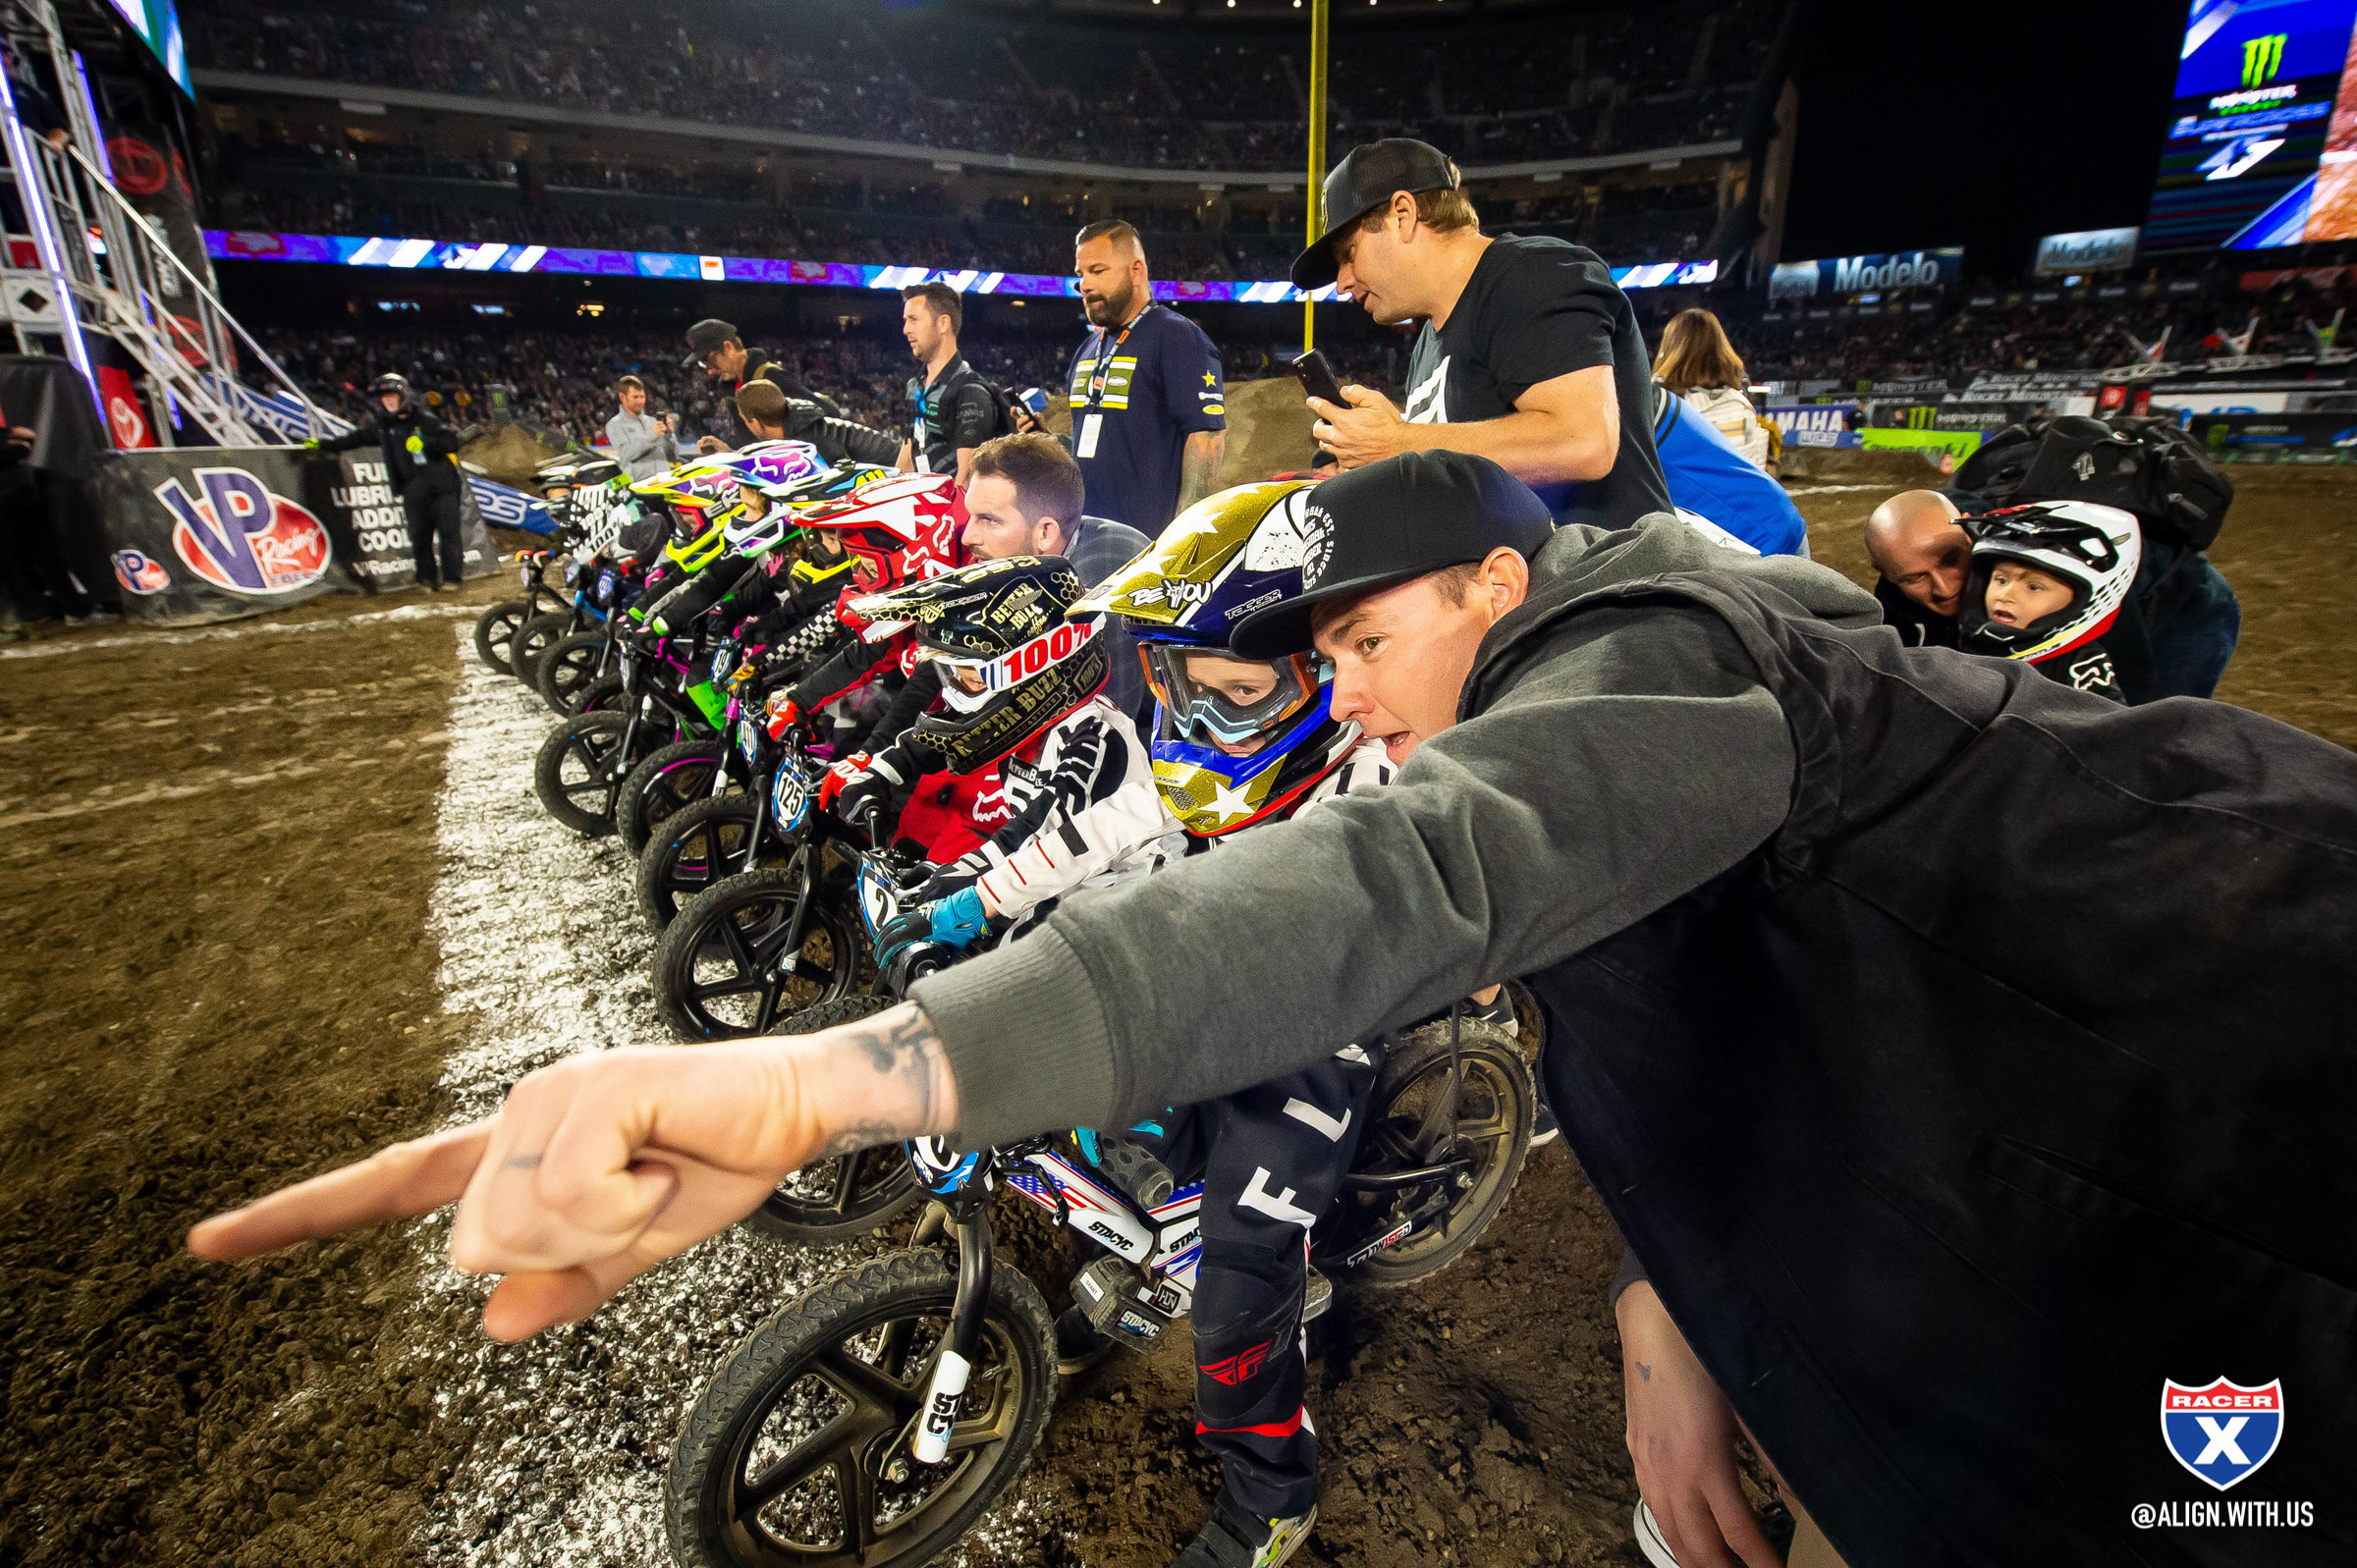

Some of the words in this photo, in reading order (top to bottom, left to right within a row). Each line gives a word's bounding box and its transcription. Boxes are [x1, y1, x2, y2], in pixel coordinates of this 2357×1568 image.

[1833, 250, 1940, 293] Modelo
[1765, 410, 1843, 435] AMAHA
[155, 467, 276, 590] VP
[255, 526, 323, 577] Racing
[990, 582, 1035, 625] BETTER
[1128, 587, 1166, 607] BE
[1004, 622, 1092, 684] 100%
[1080, 659, 1102, 684] 100%
[1015, 669, 1063, 714] BUZZ
[779, 776, 804, 816] 125
[1087, 1220, 1134, 1251] STACYC
[1084, 1279, 1099, 1295] GRANT
[1120, 1310, 1161, 1337] STACYC
